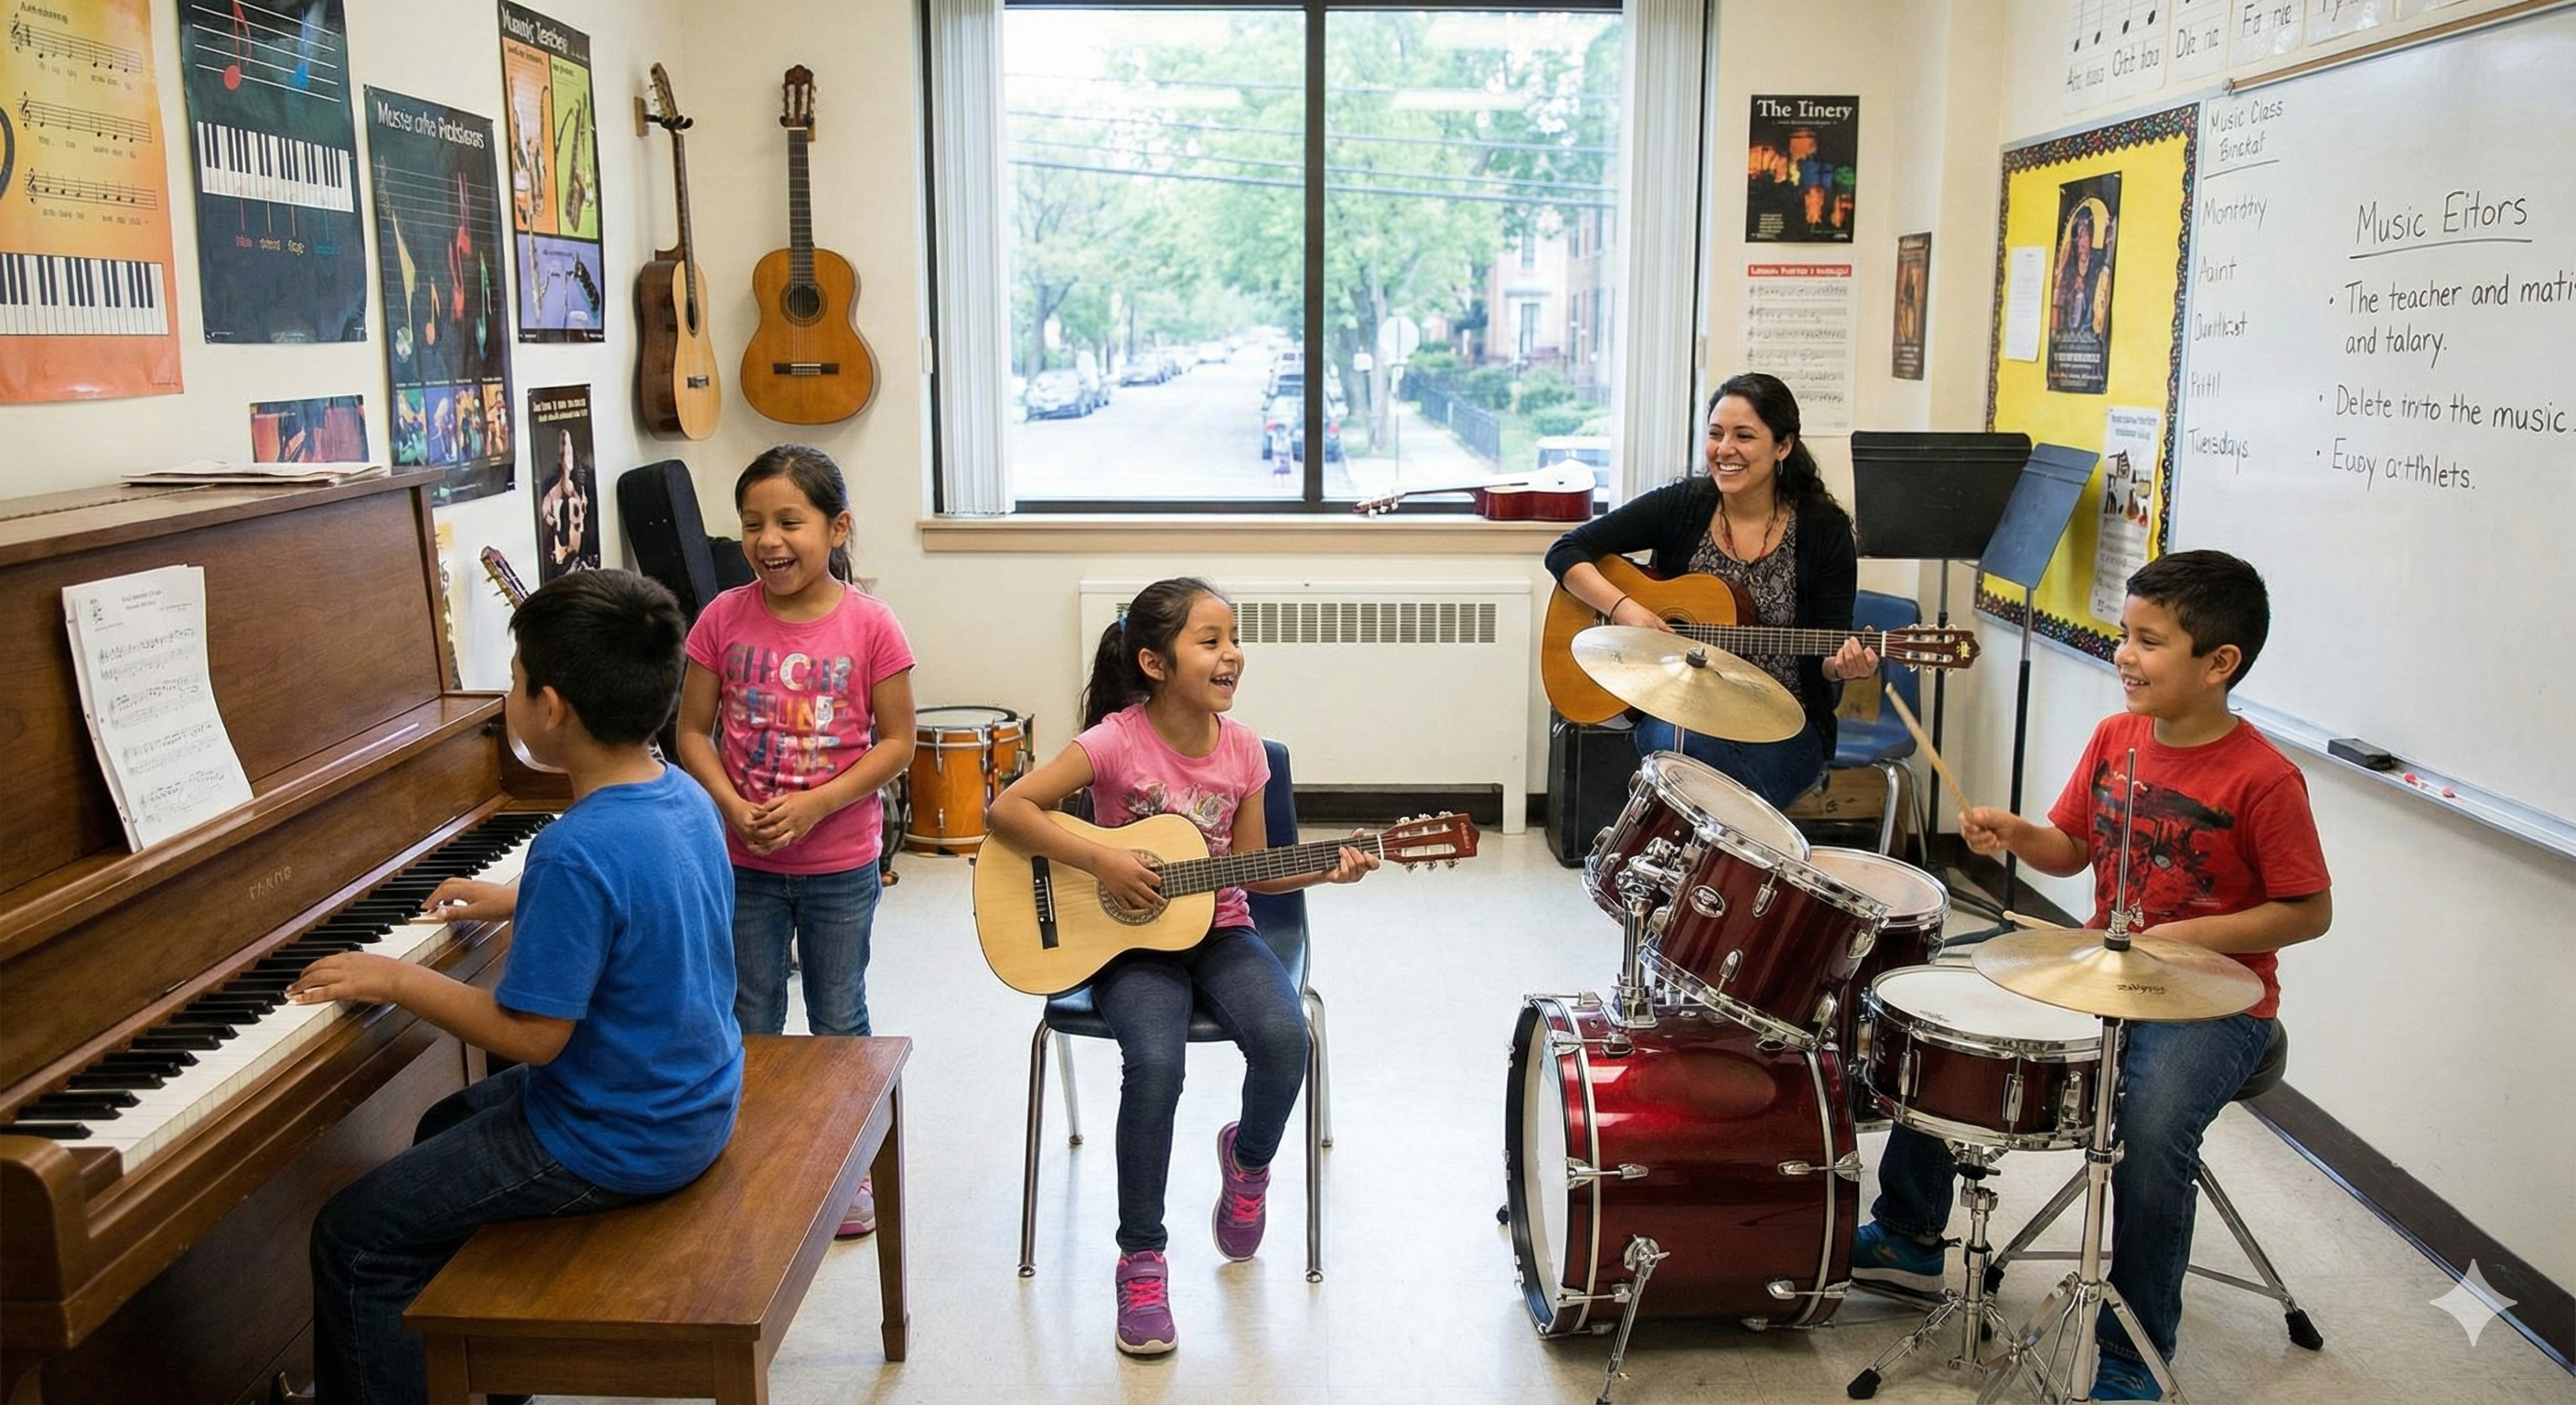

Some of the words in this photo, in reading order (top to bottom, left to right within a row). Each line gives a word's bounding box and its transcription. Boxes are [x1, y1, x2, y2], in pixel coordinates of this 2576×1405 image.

[1756, 100, 1792, 117] The
[2210, 107, 2244, 135] Music
[2356, 201, 2426, 245] Music
[2443, 190, 2528, 233] Eitors
[2345, 279, 2378, 315] The
[2388, 278, 2463, 311] teacher
[2471, 273, 2509, 306] and
[2520, 269, 2576, 304] mati
[2345, 326, 2377, 354] and
[2336, 383, 2392, 418] Delete
[2450, 392, 2483, 425] the
